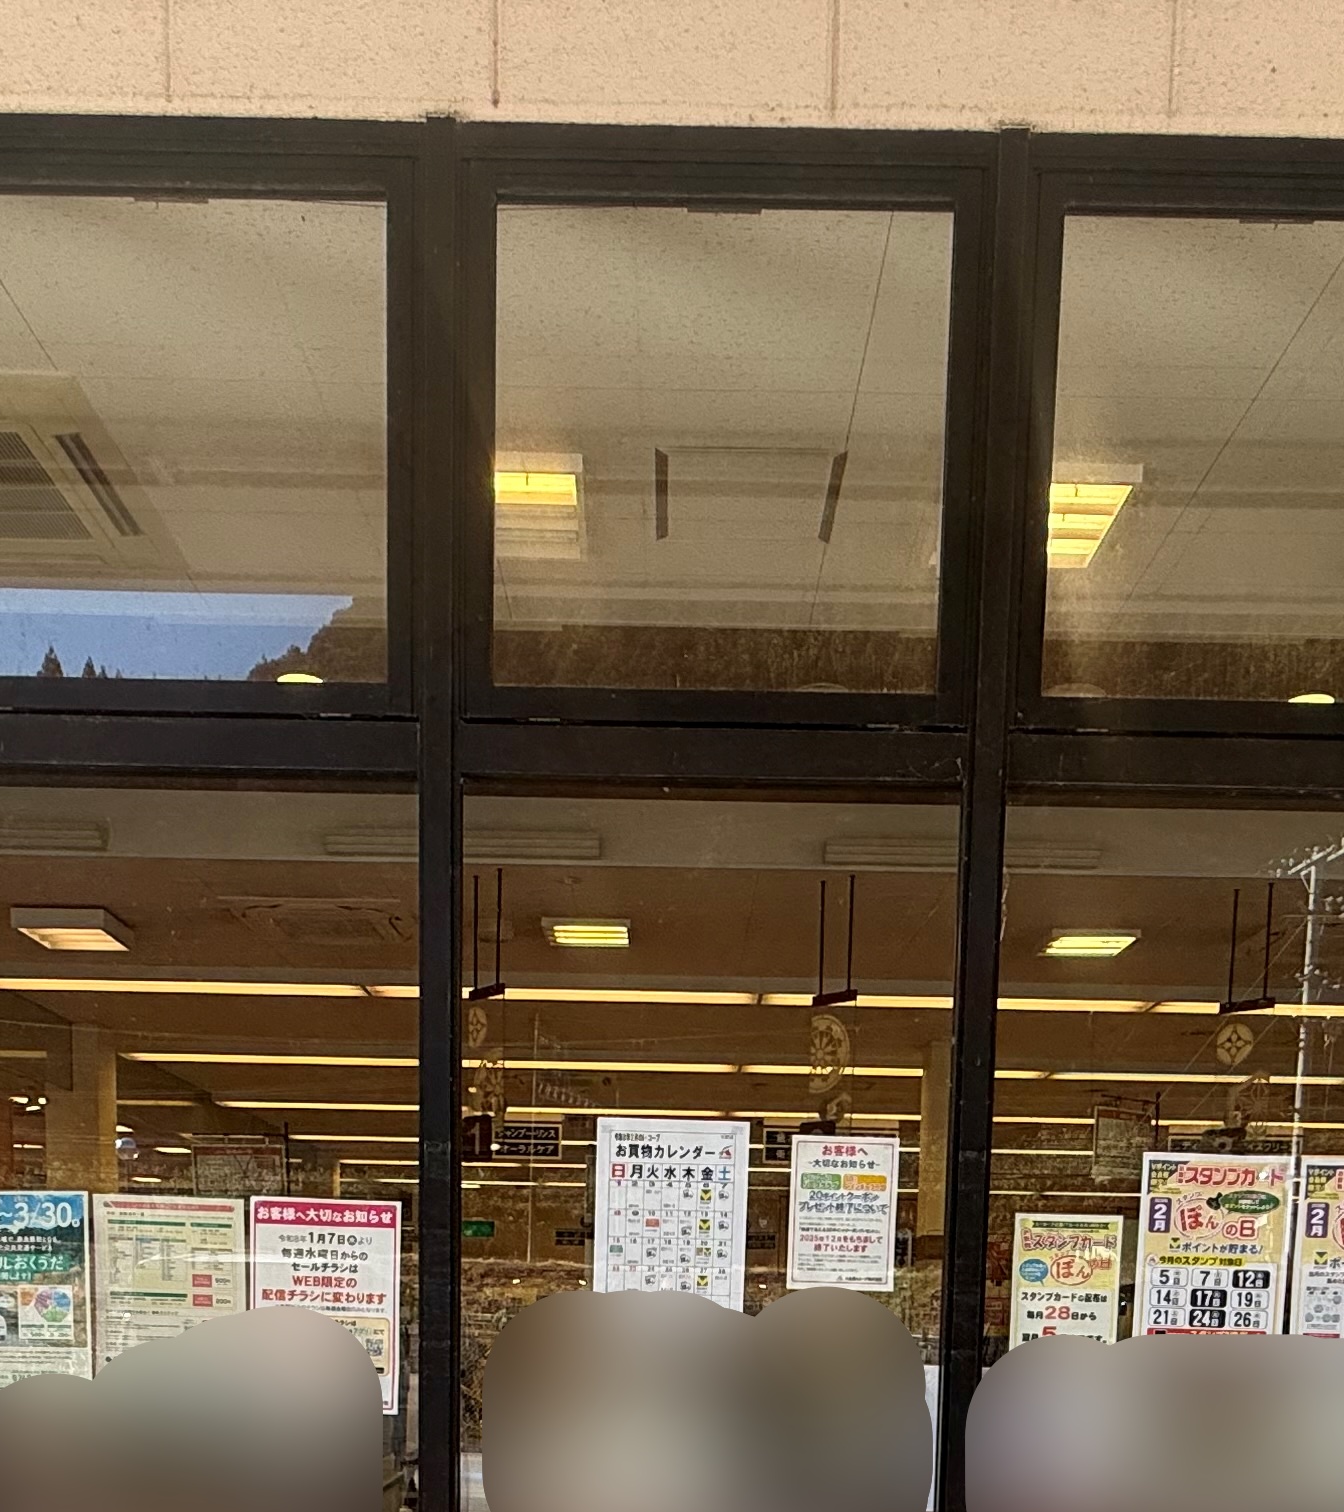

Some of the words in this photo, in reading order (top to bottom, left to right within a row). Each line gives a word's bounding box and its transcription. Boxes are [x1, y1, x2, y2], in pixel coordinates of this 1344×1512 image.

[615, 1144, 716, 1160] お買物カレンダー
[822, 1145, 868, 1156] お客様へ
[612, 1163, 625, 1178] 日
[630, 1163, 643, 1179] 月
[646, 1165, 659, 1179] 火
[664, 1165, 677, 1180] 水
[682, 1166, 695, 1180] 木
[701, 1166, 714, 1181] 金
[718, 1166, 731, 1181] 土
[256, 1206, 393, 1225] お客様へ大切なお知らせ
[1153, 1204, 1168, 1232] 2月
[1309, 1208, 1325, 1237] 2月
[281, 1247, 369, 1261] 毎週水曜日からの
[291, 1262, 359, 1274] セールチラシは
[291, 1275, 358, 1289] WEB限定の
[1237, 1271, 1256, 1288] 12
[261, 1288, 387, 1305] 配信チラシに変わります
[1156, 1289, 1172, 1305] 14
[1195, 1290, 1213, 1306] 17
[1237, 1292, 1254, 1308] 19
[1026, 1305, 1097, 1321] 毎月28日から
[1153, 1309, 1169, 1325] 21
[1192, 1310, 1213, 1327] 24
[1234, 1312, 1252, 1328] 26
